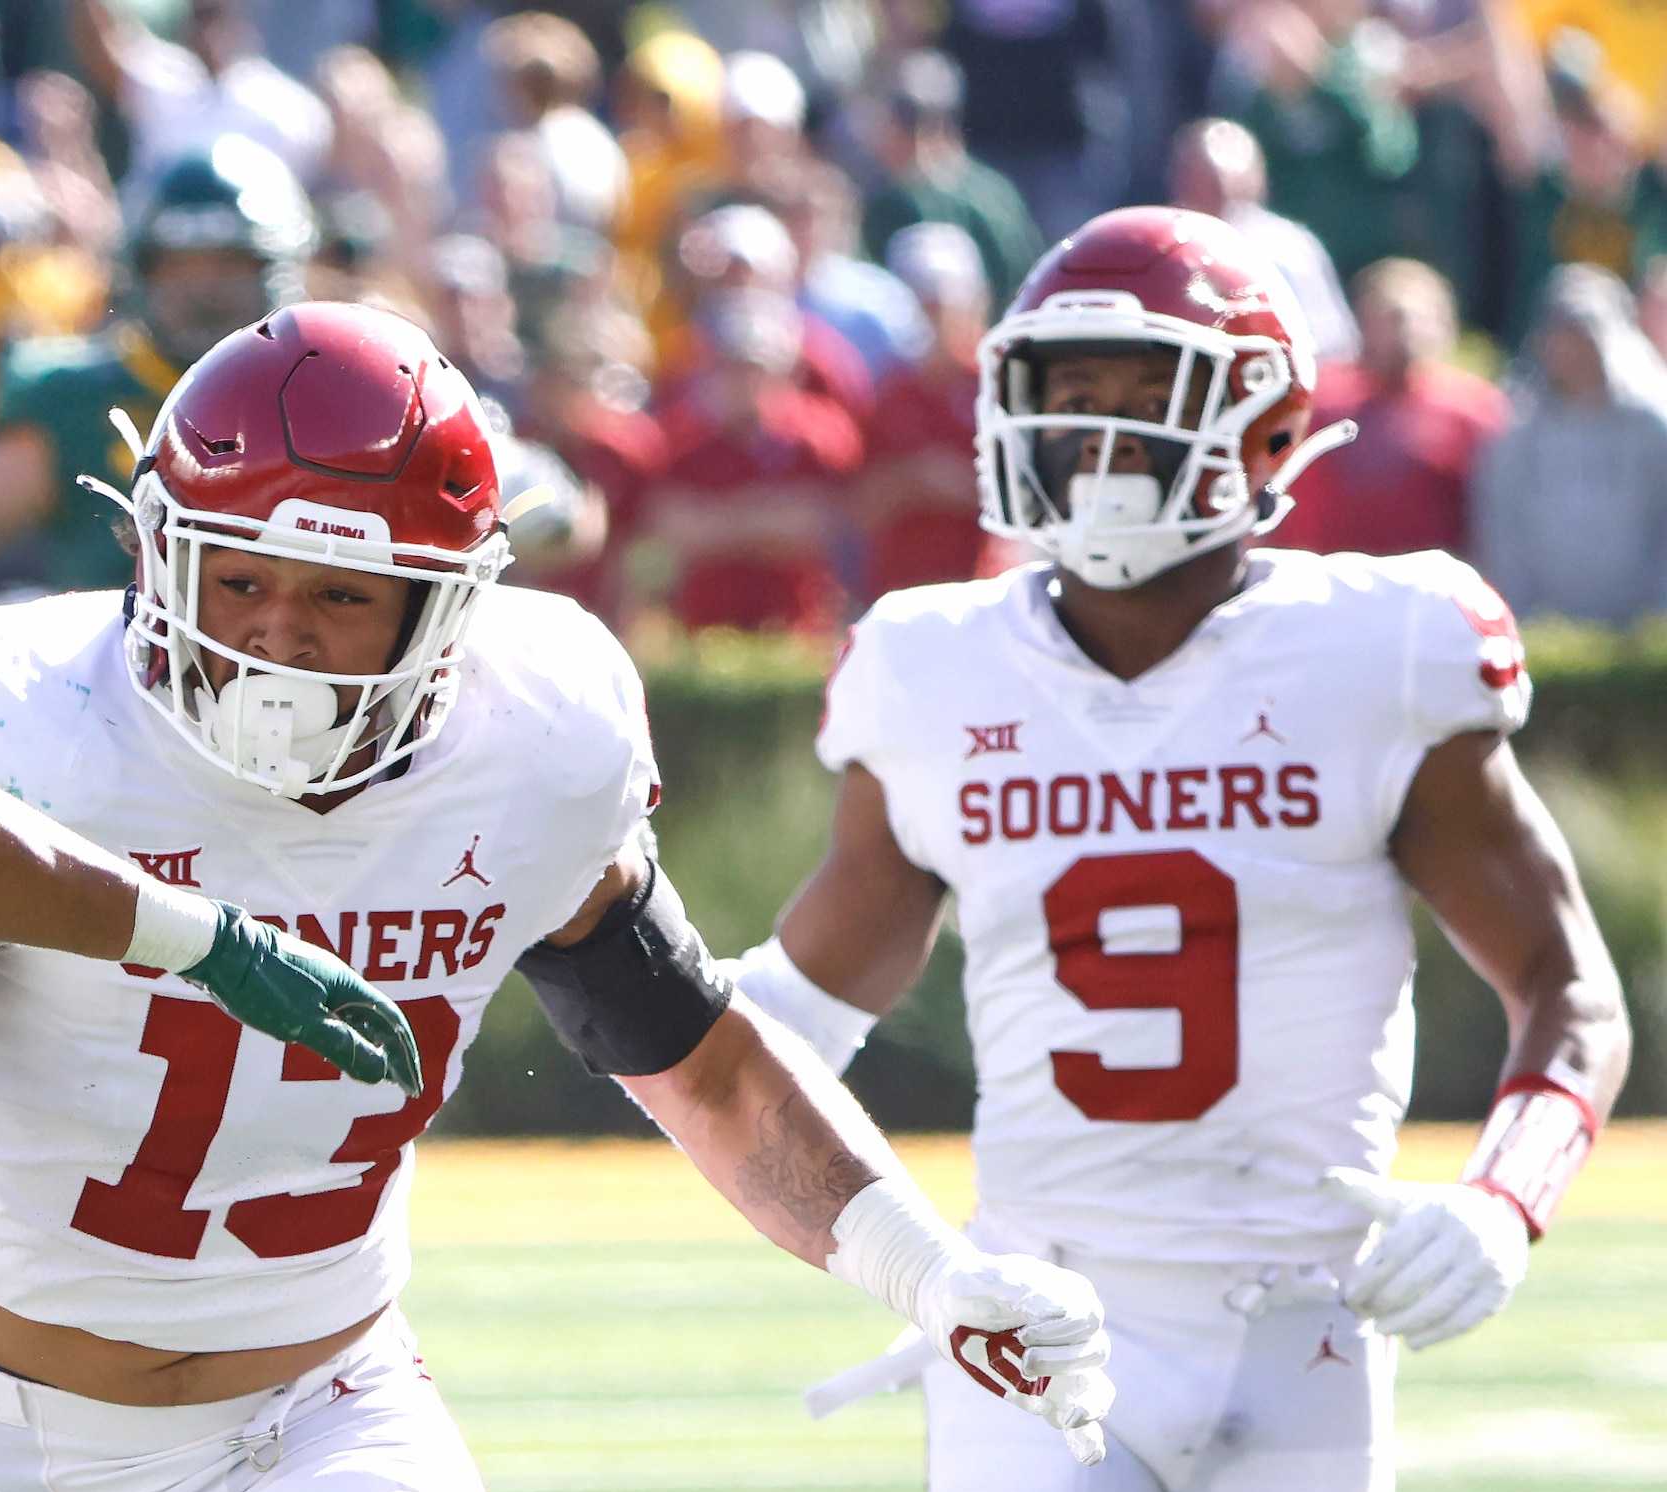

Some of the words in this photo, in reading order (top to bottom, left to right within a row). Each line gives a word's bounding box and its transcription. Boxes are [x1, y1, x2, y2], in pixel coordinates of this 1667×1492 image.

[963, 720, 1024, 762] XII
[958, 763, 1322, 846] SOONERS
[120, 903, 507, 983] NERS
[1041, 847, 1240, 1124] 9
[70, 993, 462, 1260] 13
